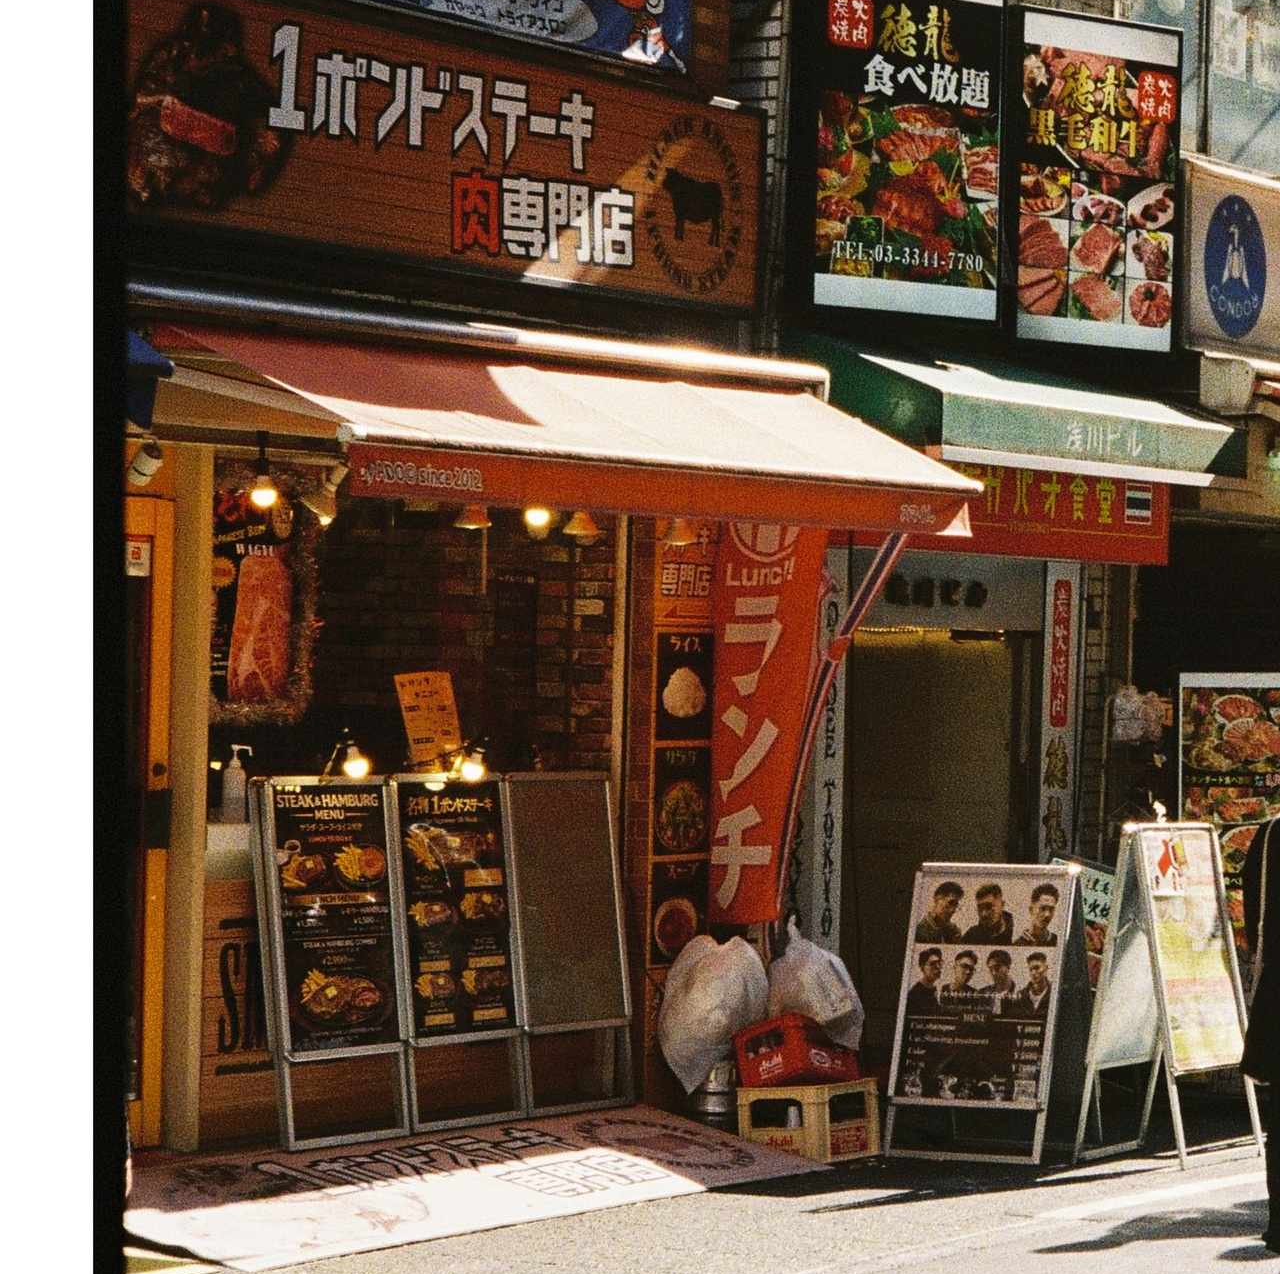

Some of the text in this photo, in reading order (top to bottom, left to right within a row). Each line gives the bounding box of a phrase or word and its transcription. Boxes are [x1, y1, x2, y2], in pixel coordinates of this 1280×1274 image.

[266, 23, 596, 171] 1ポンドステーキ
[862, 52, 992, 110] 食べ放題
[1025, 107, 1145, 159] 黒毛和牛
[449, 168, 636, 268] 肉専門店
[418, 463, 453, 489] since
[453, 466, 484, 493] 2012
[660, 562, 713, 598] 専門店
[669, 633, 704, 654] ライス
[710, 595, 784, 911] ランチ
[314, 809, 346, 820] MENU
